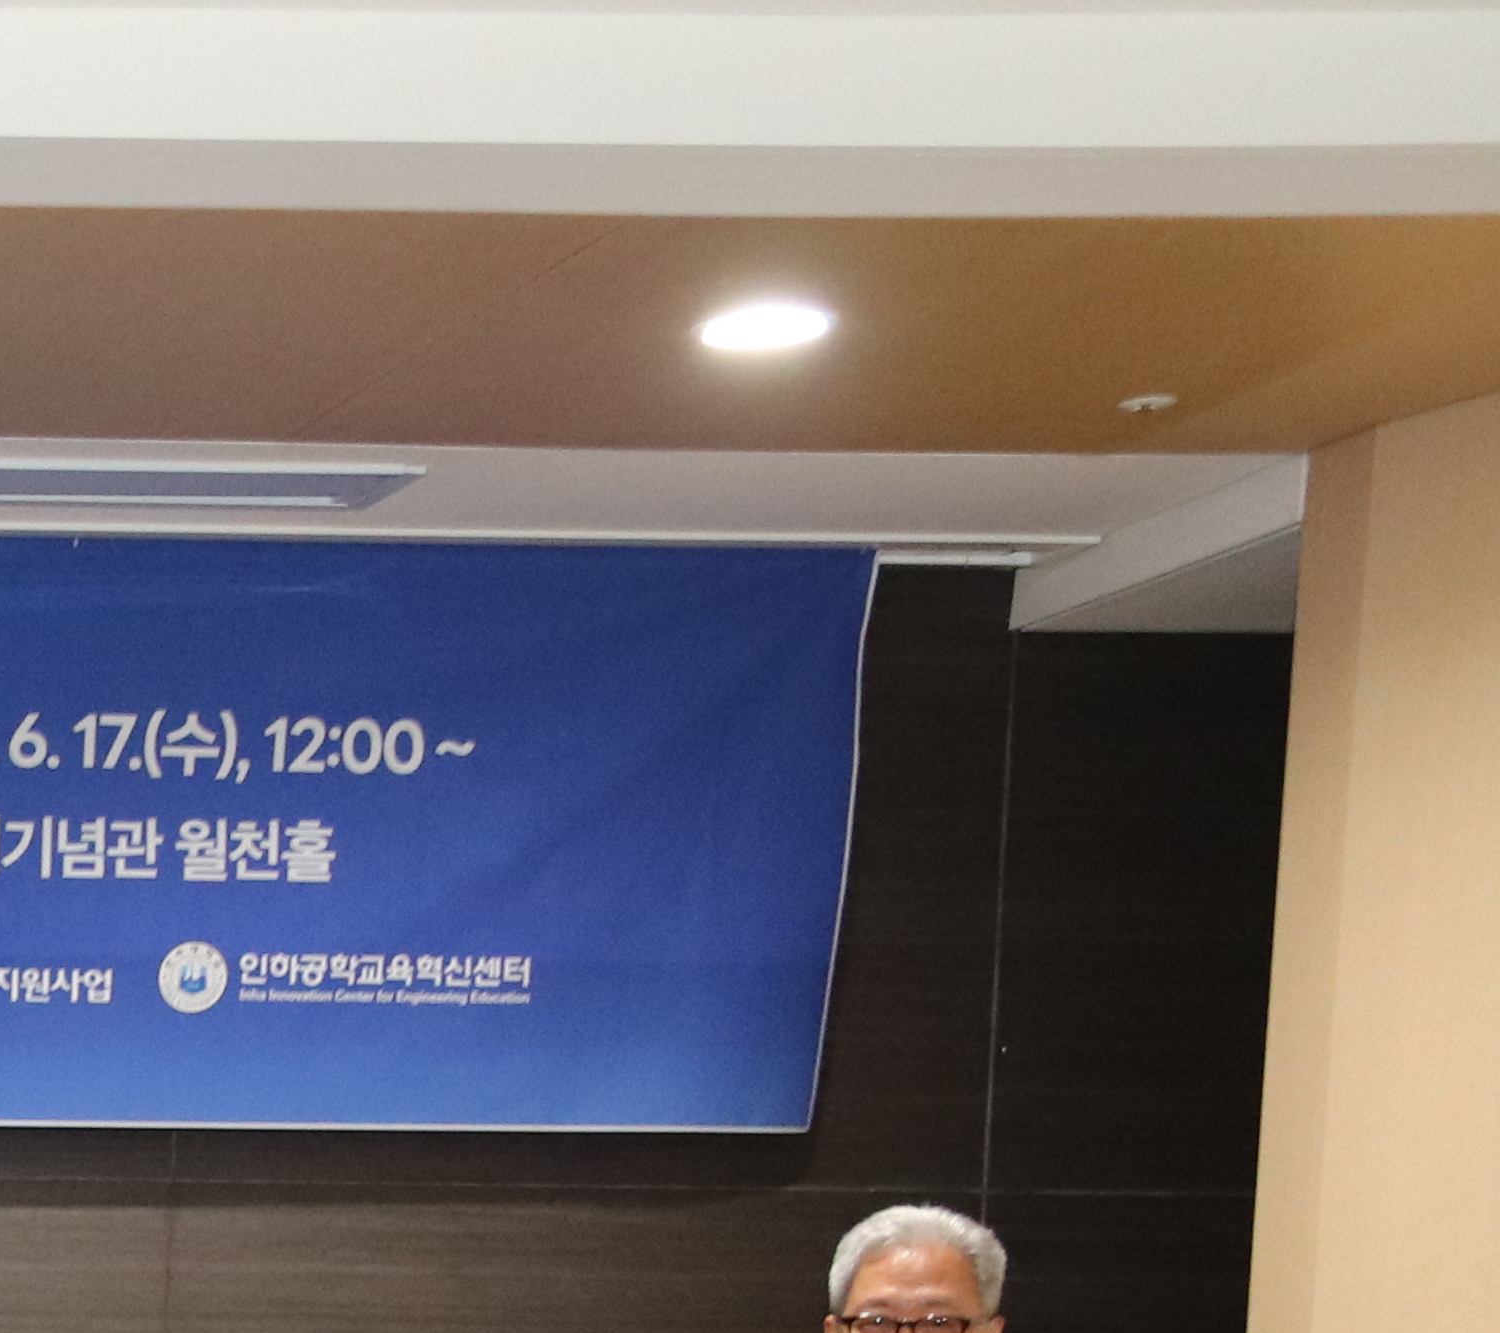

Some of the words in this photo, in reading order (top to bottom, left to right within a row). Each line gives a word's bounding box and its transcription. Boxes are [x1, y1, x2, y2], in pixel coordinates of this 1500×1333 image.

[9, 713, 60, 768] 6.
[265, 717, 424, 774] 12:00
[175, 819, 336, 882] 월천홀
[240, 953, 531, 987] 인하공학교육혁신센터
